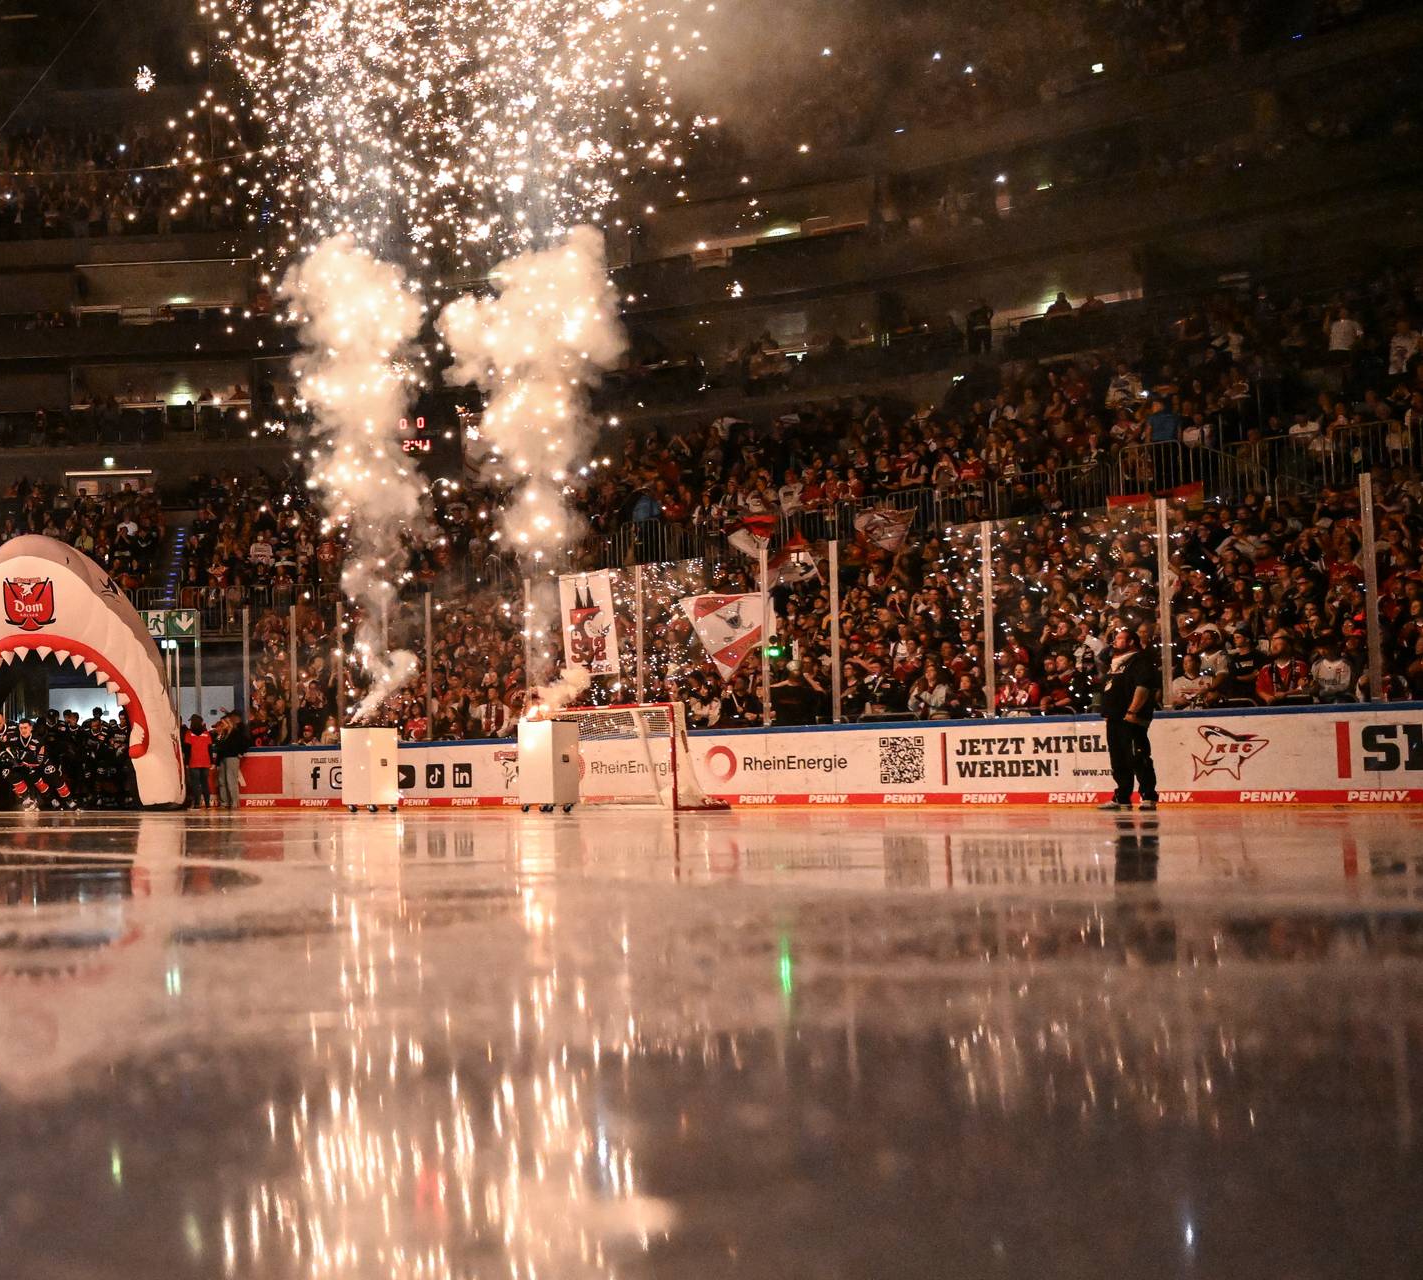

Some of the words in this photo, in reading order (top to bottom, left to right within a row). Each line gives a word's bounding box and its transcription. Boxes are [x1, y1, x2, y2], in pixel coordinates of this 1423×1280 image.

[13, 599, 44, 613] Dom
[955, 737, 1025, 756] JETZT
[1215, 743, 1254, 754] KEC
[743, 755, 848, 773] RheinEnergie
[956, 758, 1059, 778] WERDEN!
